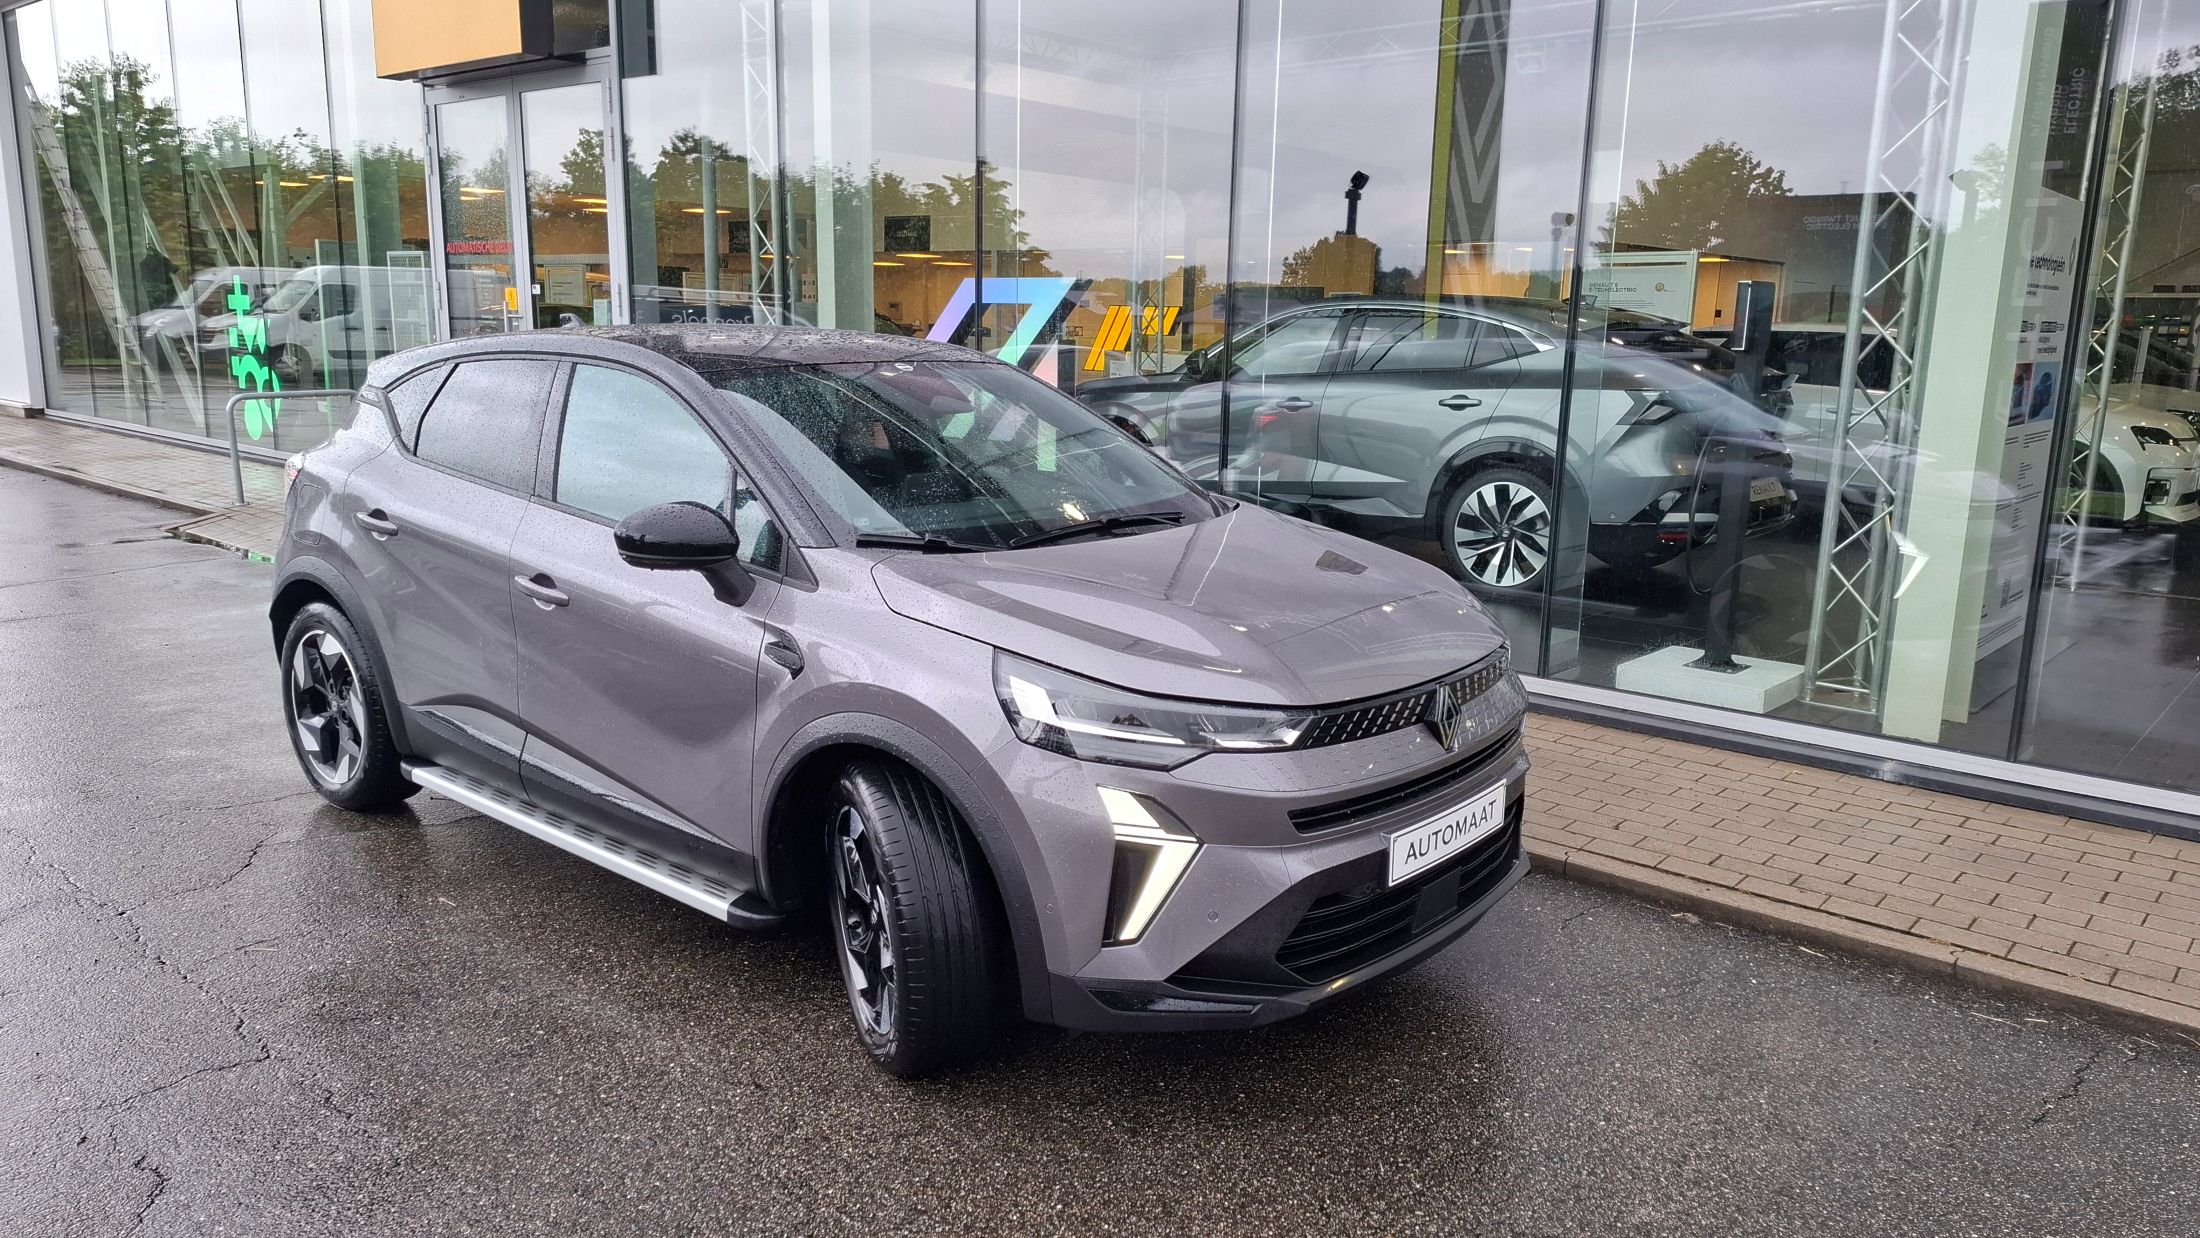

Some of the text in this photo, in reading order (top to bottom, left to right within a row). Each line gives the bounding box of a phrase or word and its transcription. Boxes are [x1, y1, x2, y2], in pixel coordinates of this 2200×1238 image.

[446, 242, 495, 254] AUTOMATISCHE
[1751, 482, 1776, 495] RENAULT
[1404, 799, 1497, 865] AUTOMAAT
